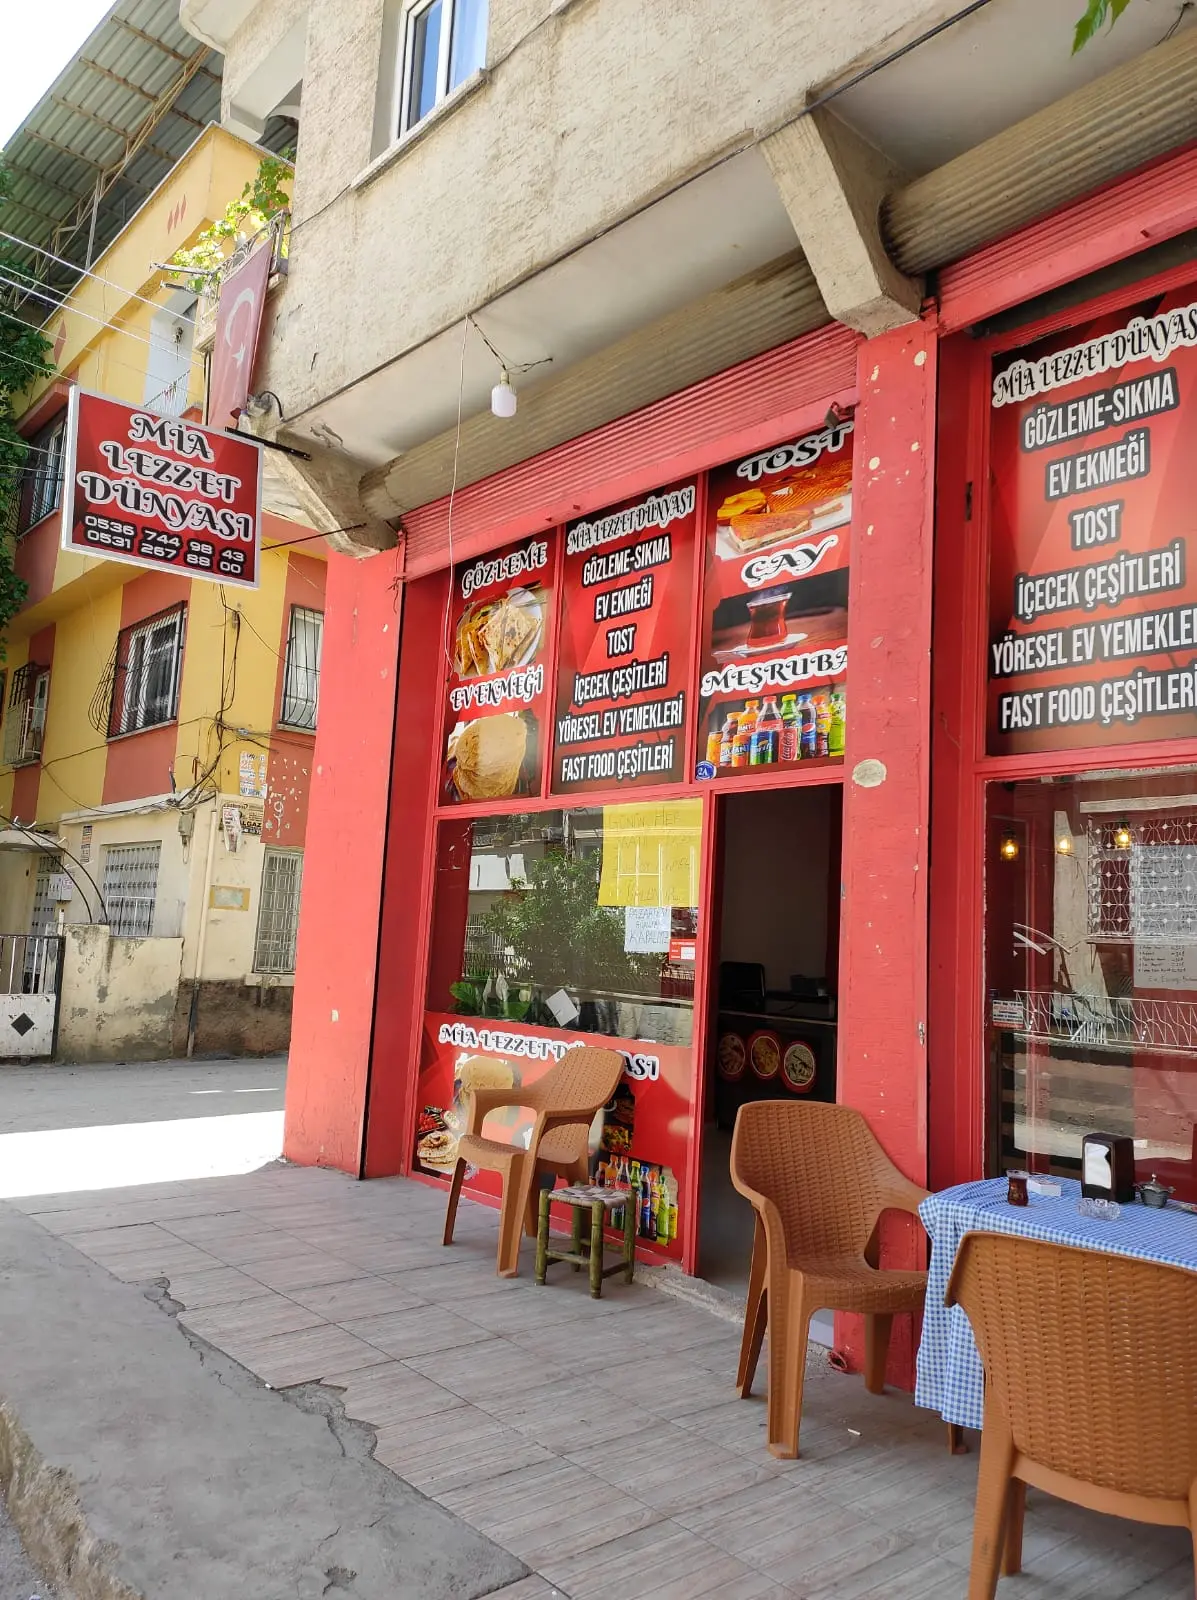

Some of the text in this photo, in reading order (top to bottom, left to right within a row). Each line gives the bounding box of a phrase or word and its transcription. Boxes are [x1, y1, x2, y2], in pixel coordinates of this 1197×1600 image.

[996, 364, 1036, 402] MİA
[1039, 340, 1109, 386] LEZZET
[1024, 372, 1175, 449] GÖZLEME-SIKMA
[130, 414, 213, 461] MİA
[738, 423, 852, 479] TOST
[101, 443, 240, 502] LEZZET
[1049, 432, 1145, 497] EV EKMEĞİ
[79, 472, 252, 539] DÜNYASI
[568, 488, 694, 554] MİA LEZZET DÜNYASI
[1072, 503, 1120, 546] TOST
[85, 515, 245, 562] 0536 744 98 43
[87, 530, 242, 574] 0531 267 88 00
[583, 536, 670, 585] GÖZLEME-SIKMA
[463, 542, 547, 597] GÖZLEME
[1018, 542, 1181, 620] İÇECEK ÇEŞİTLERİ
[595, 577, 652, 620] EV EKMEĞİ
[607, 626, 635, 655] TOST
[992, 631, 1067, 675] YÖRESEL
[1072, 626, 1095, 662] EV
[451, 665, 542, 710] EV EKMEĞİ
[574, 655, 668, 705] İÇECEK ÇEŞİTLERİ
[559, 694, 683, 743] YÖRESEL EV YEMEKLERİ
[1001, 692, 1044, 729] FAST
[1048, 686, 1095, 724] FOOD
[562, 739, 674, 782] FAST FOOD ÇEŞİTLERİ
[440, 1024, 477, 1047] MİA
[480, 1032, 551, 1058] LEZZET
